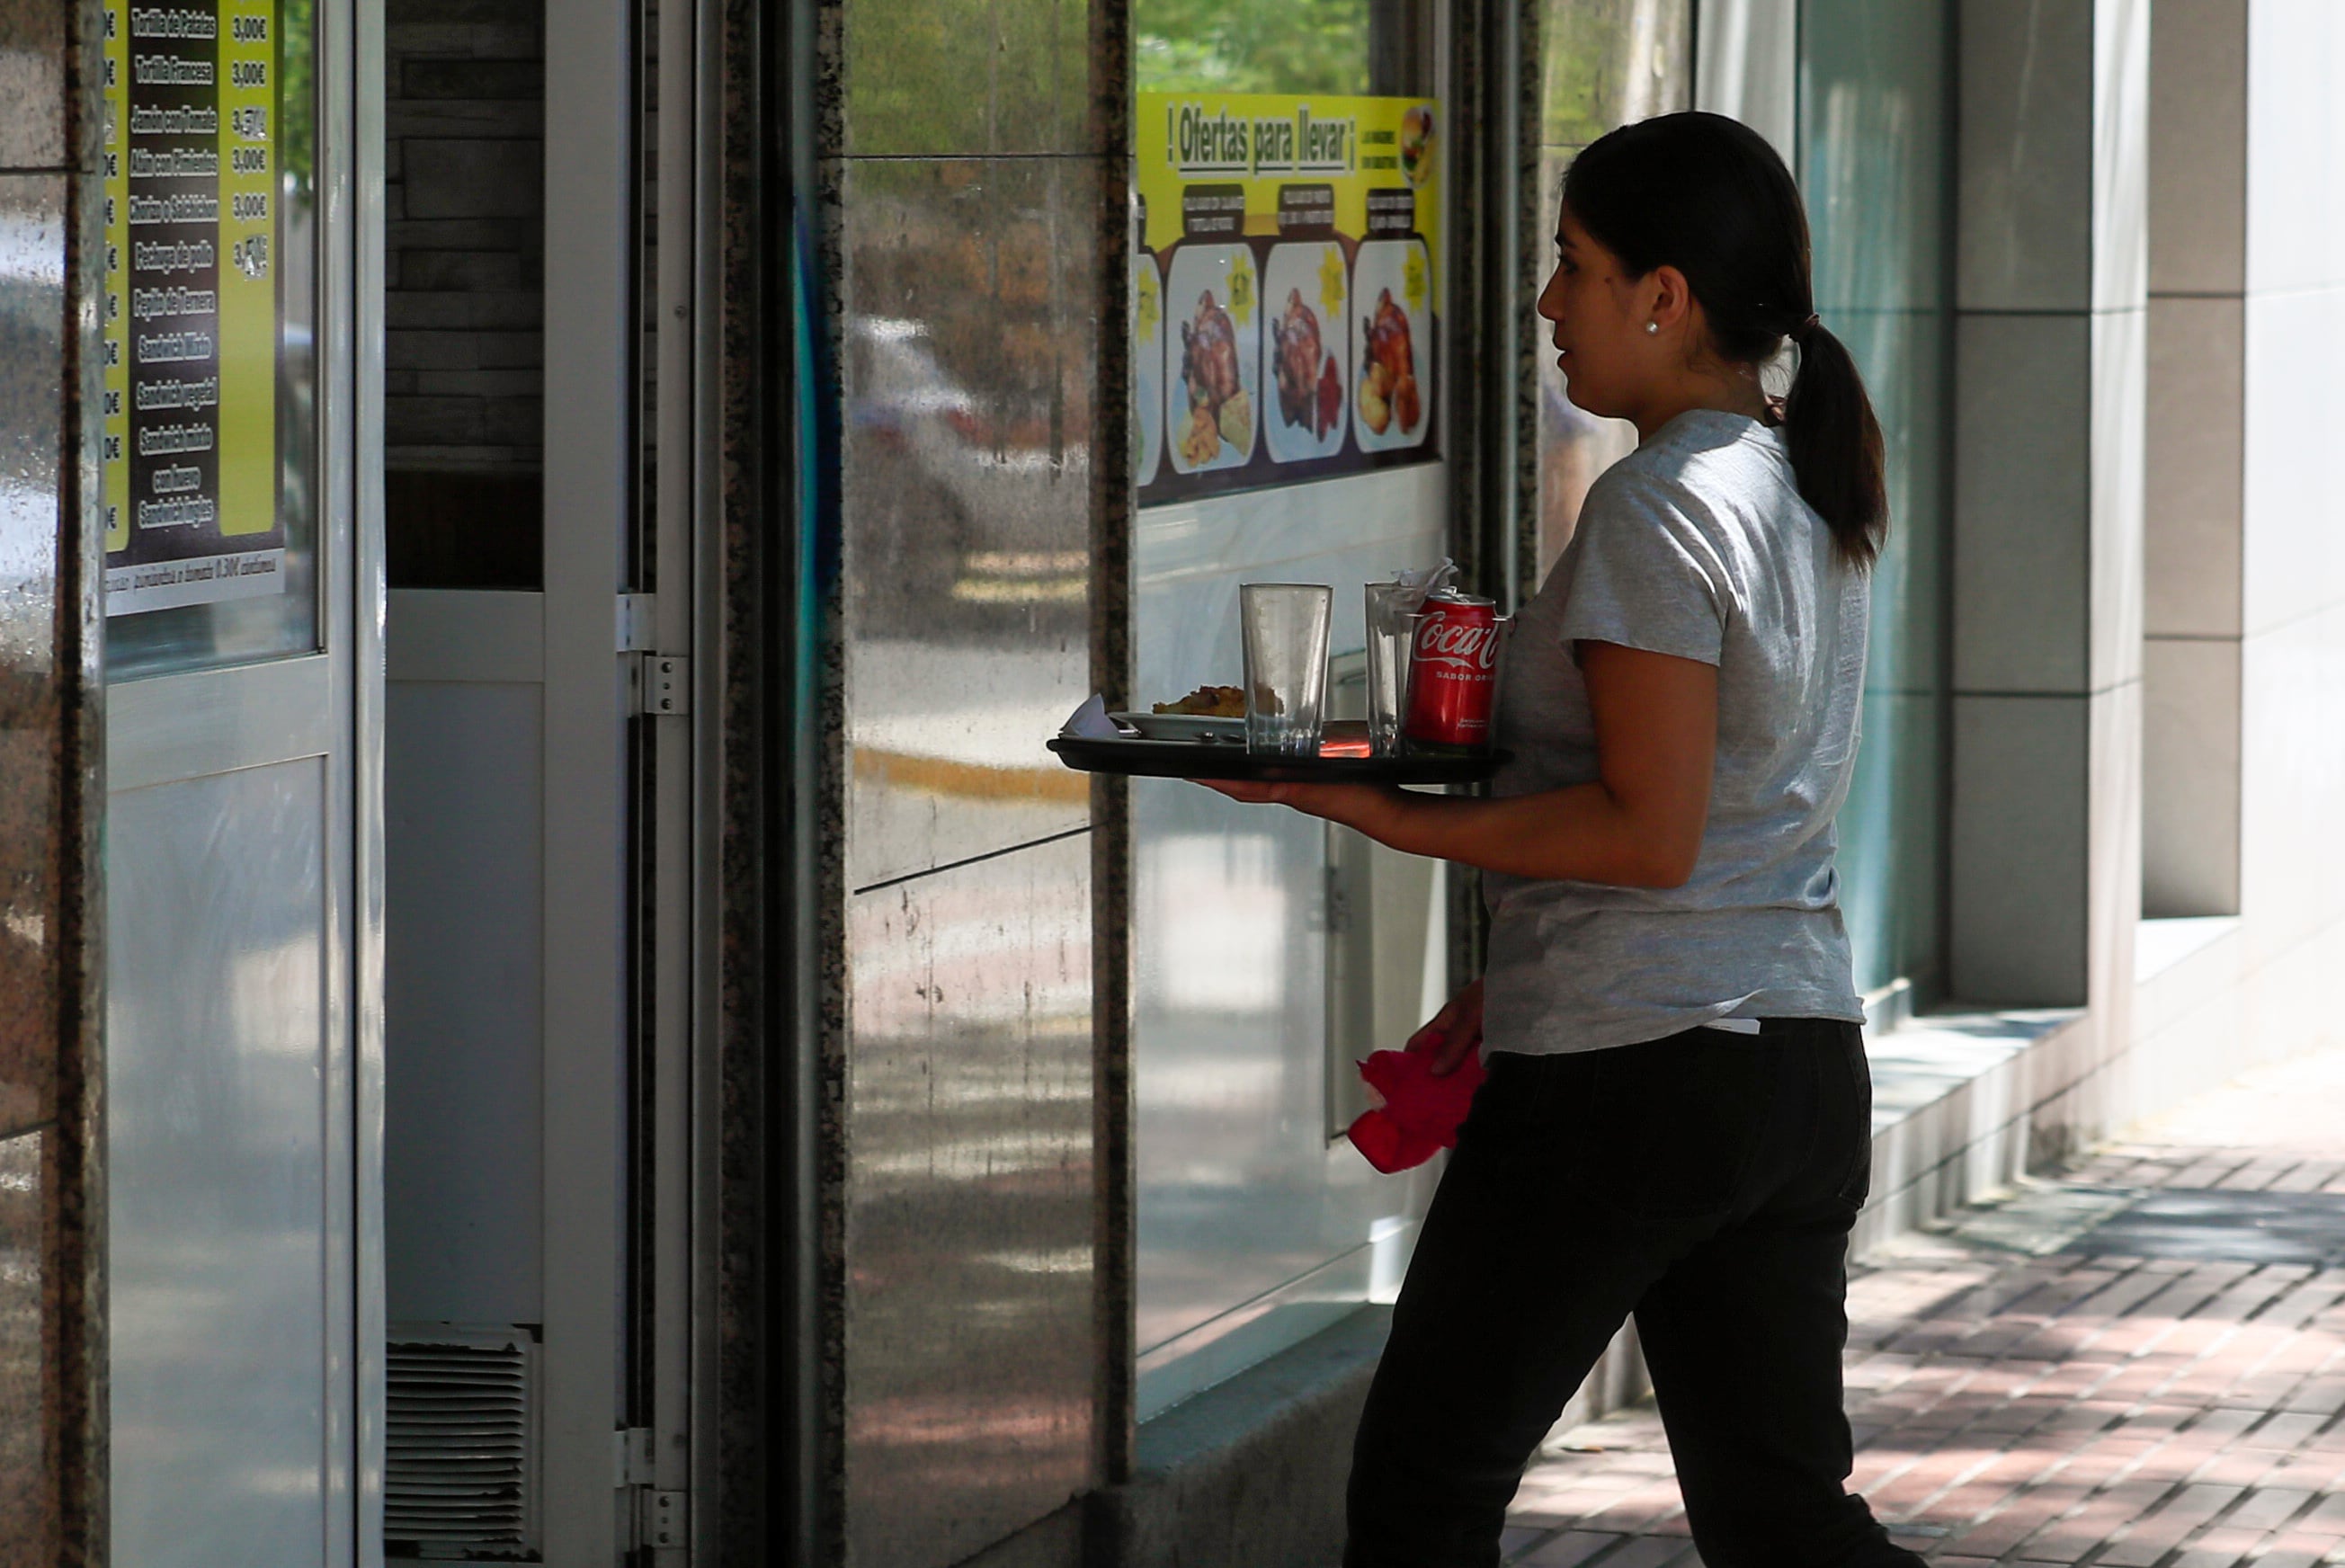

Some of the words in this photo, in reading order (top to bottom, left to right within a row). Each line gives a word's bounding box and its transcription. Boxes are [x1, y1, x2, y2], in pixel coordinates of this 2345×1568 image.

[167, 8, 180, 38] de
[232, 15, 267, 44] 3,00€
[232, 60, 267, 89] 3,00€
[1179, 102, 1248, 163] Ofertas
[1253, 119, 1293, 180] para
[1297, 104, 1346, 163] llevar
[232, 147, 267, 176] 3,00€
[232, 193, 267, 223] 3,00€
[175, 240, 190, 269] de
[1435, 671, 1472, 682] SABOR
